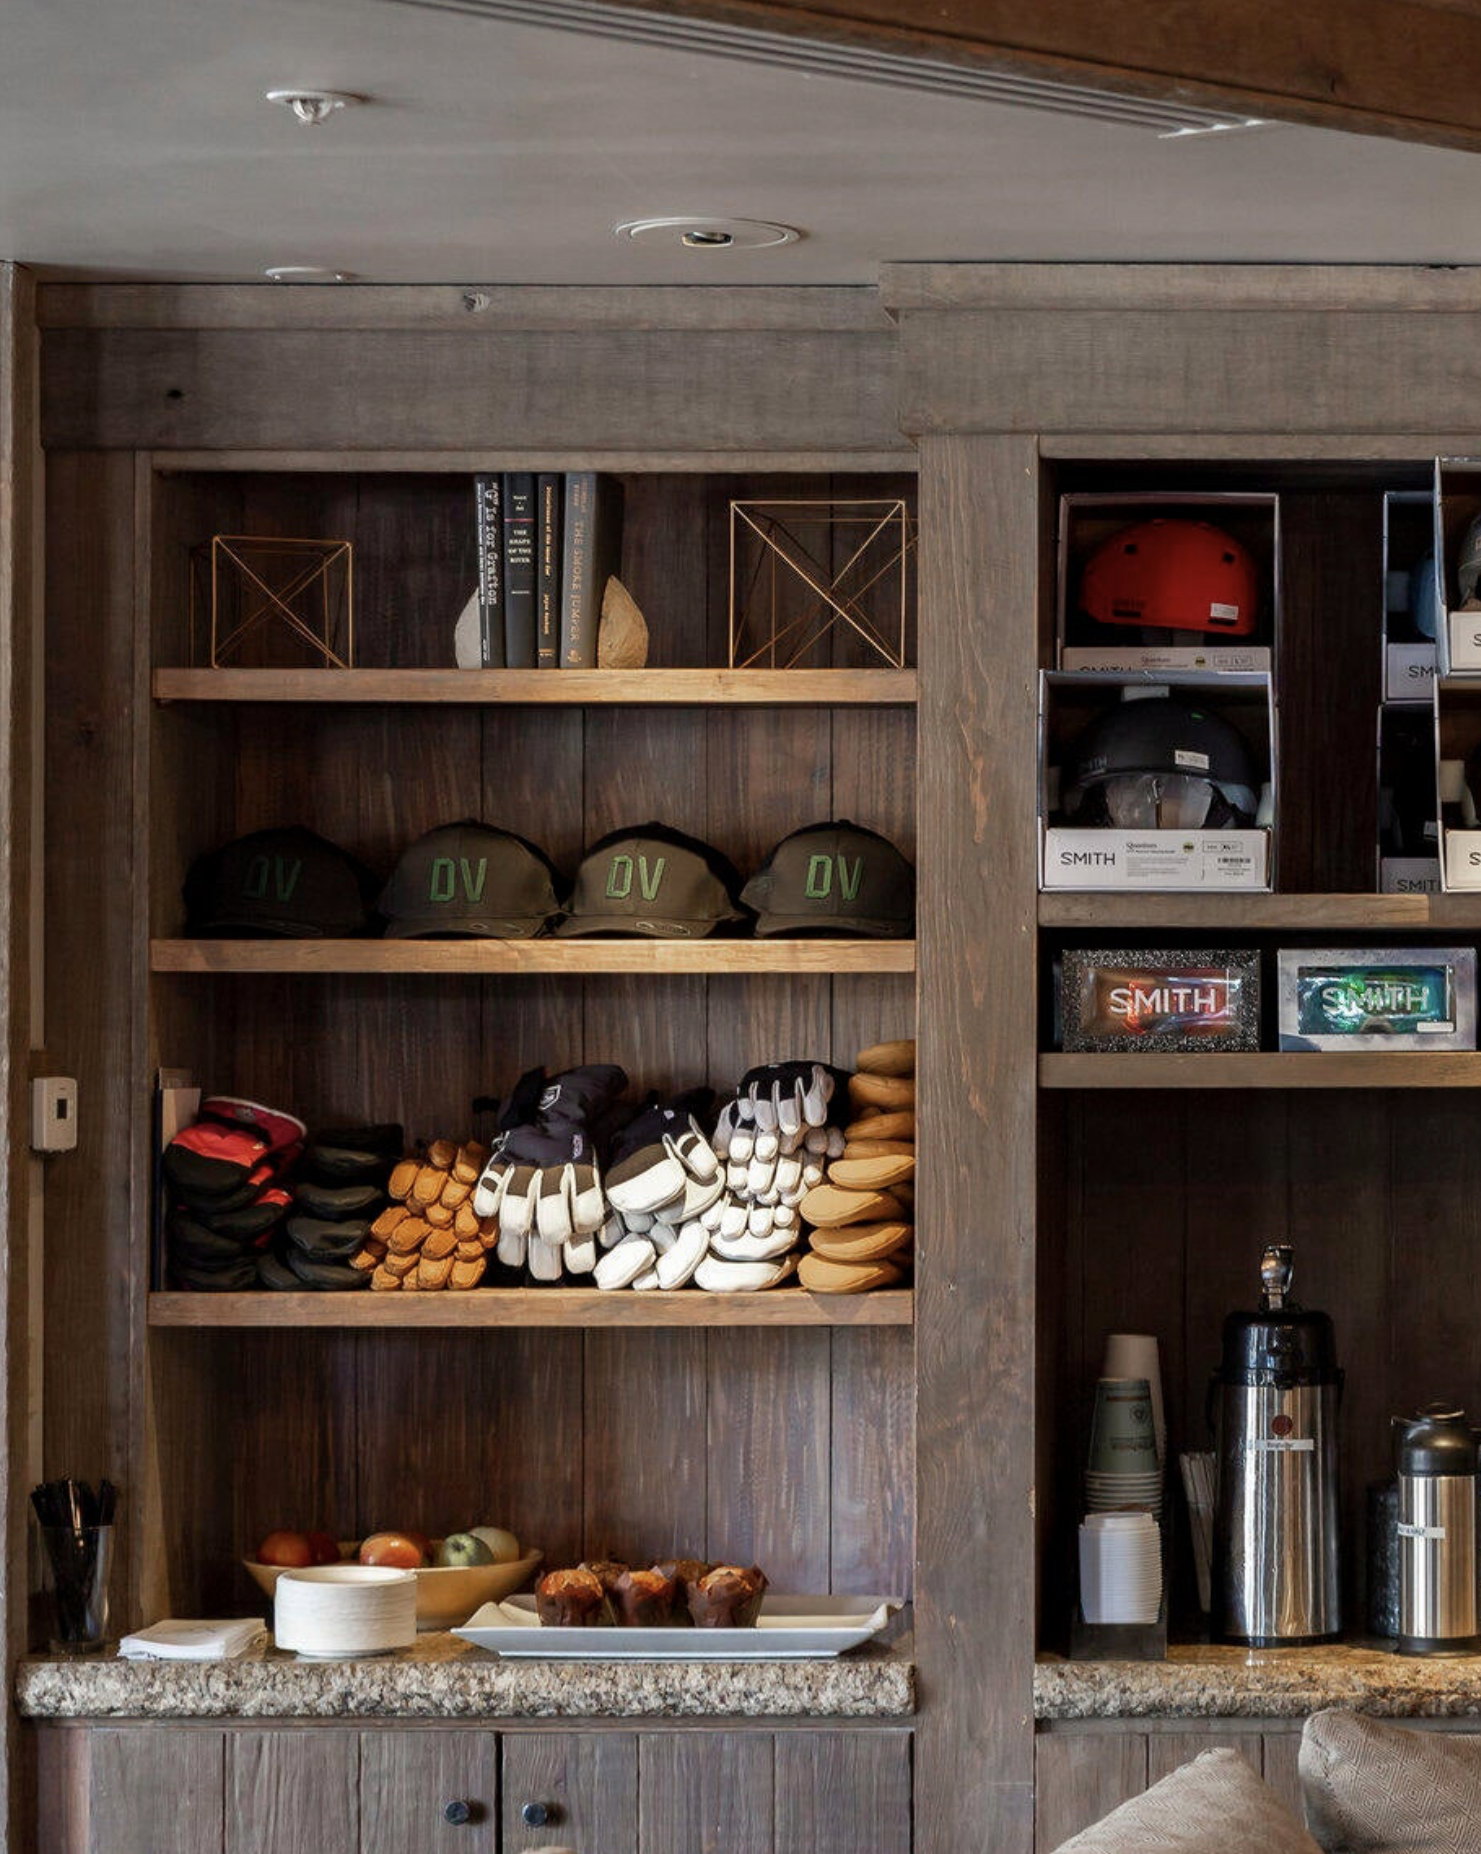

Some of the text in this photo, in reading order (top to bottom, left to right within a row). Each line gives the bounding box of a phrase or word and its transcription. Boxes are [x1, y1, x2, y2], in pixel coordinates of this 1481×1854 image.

[485, 507, 497, 521] Is
[485, 525, 497, 547] for
[486, 552, 499, 606] Grafton
[569, 522, 585, 642] THE SMOKE JUMPER
[243, 856, 301, 900] DV
[429, 856, 490, 902] DV
[605, 854, 666, 901] DV
[804, 854, 865, 901] DV
[1060, 851, 1116, 866] SMITH
[1108, 986, 1217, 1017] SMITH
[1321, 985, 1430, 1014] SMITH
